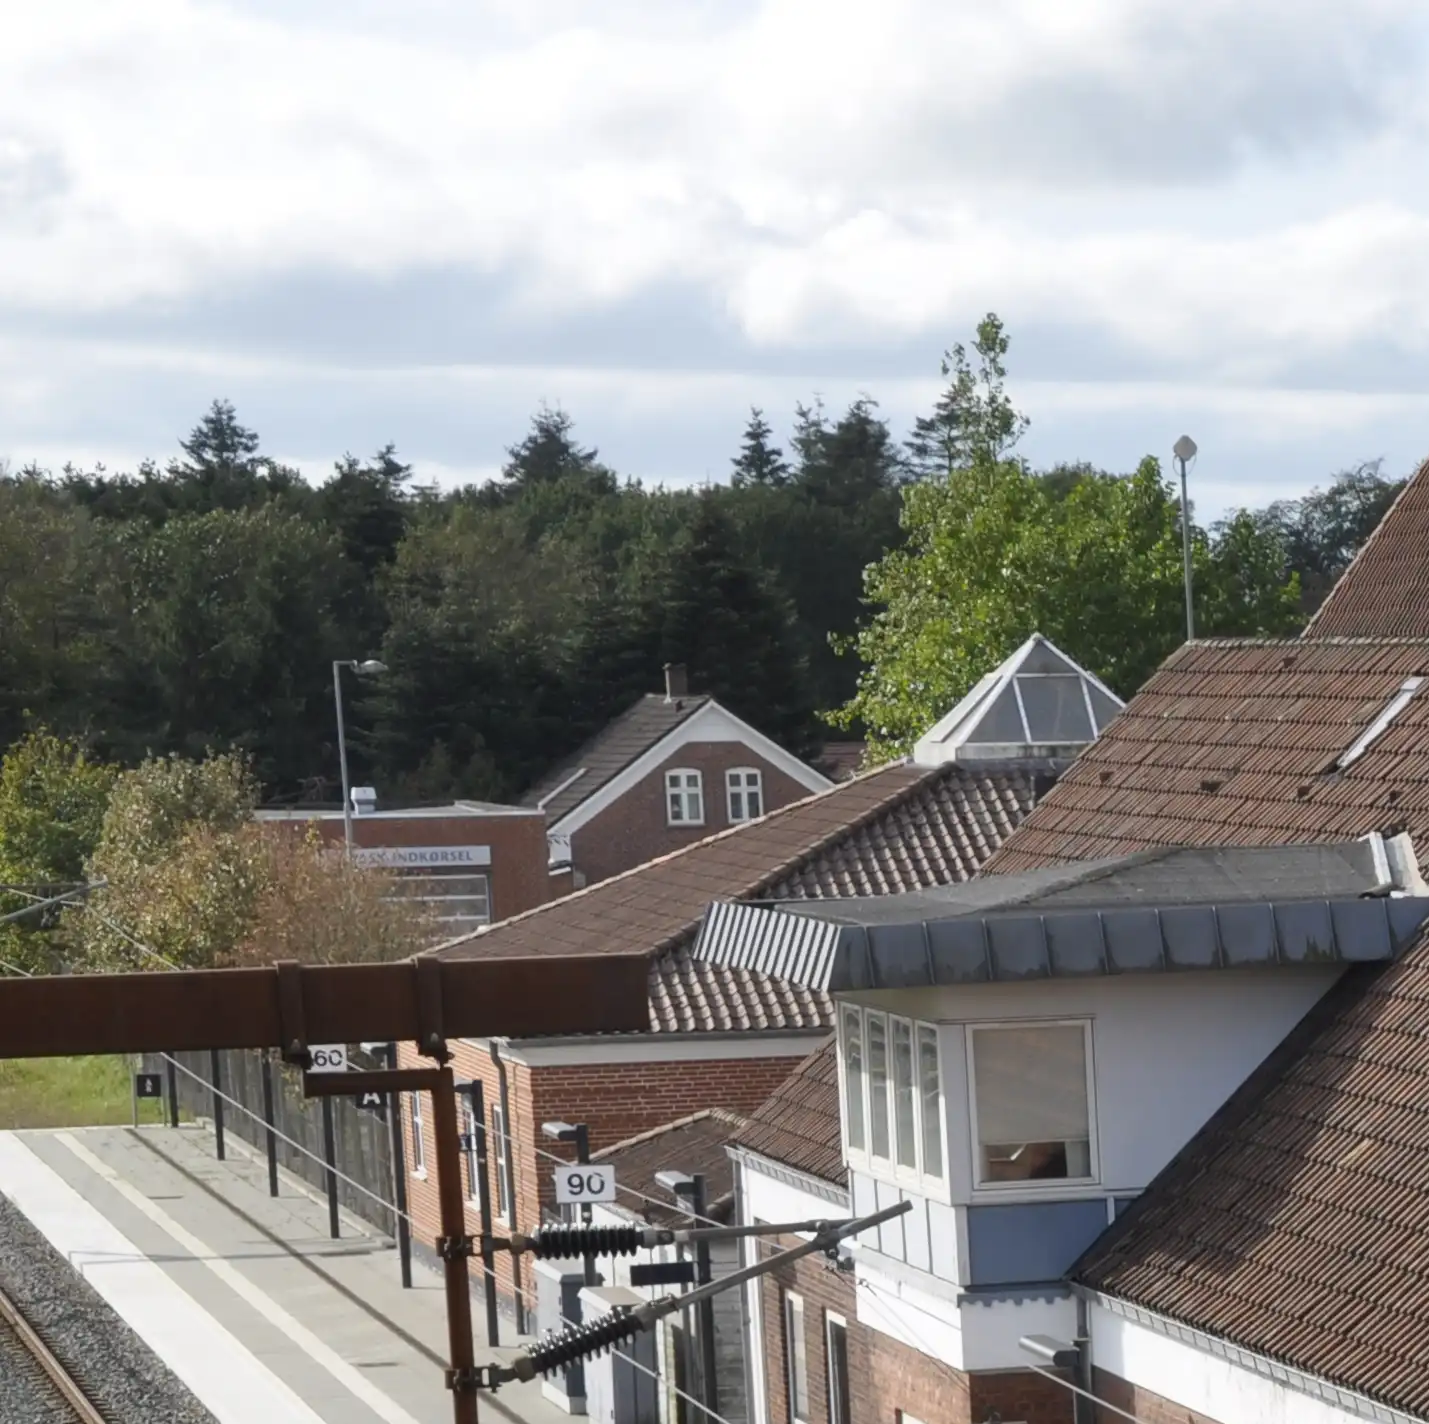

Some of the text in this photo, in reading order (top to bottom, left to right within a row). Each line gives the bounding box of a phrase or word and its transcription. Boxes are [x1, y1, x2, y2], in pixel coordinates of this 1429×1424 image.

[393, 850, 473, 863] INDKØRSEL
[313, 1049, 343, 1067] 60
[567, 1171, 605, 1196] 90
